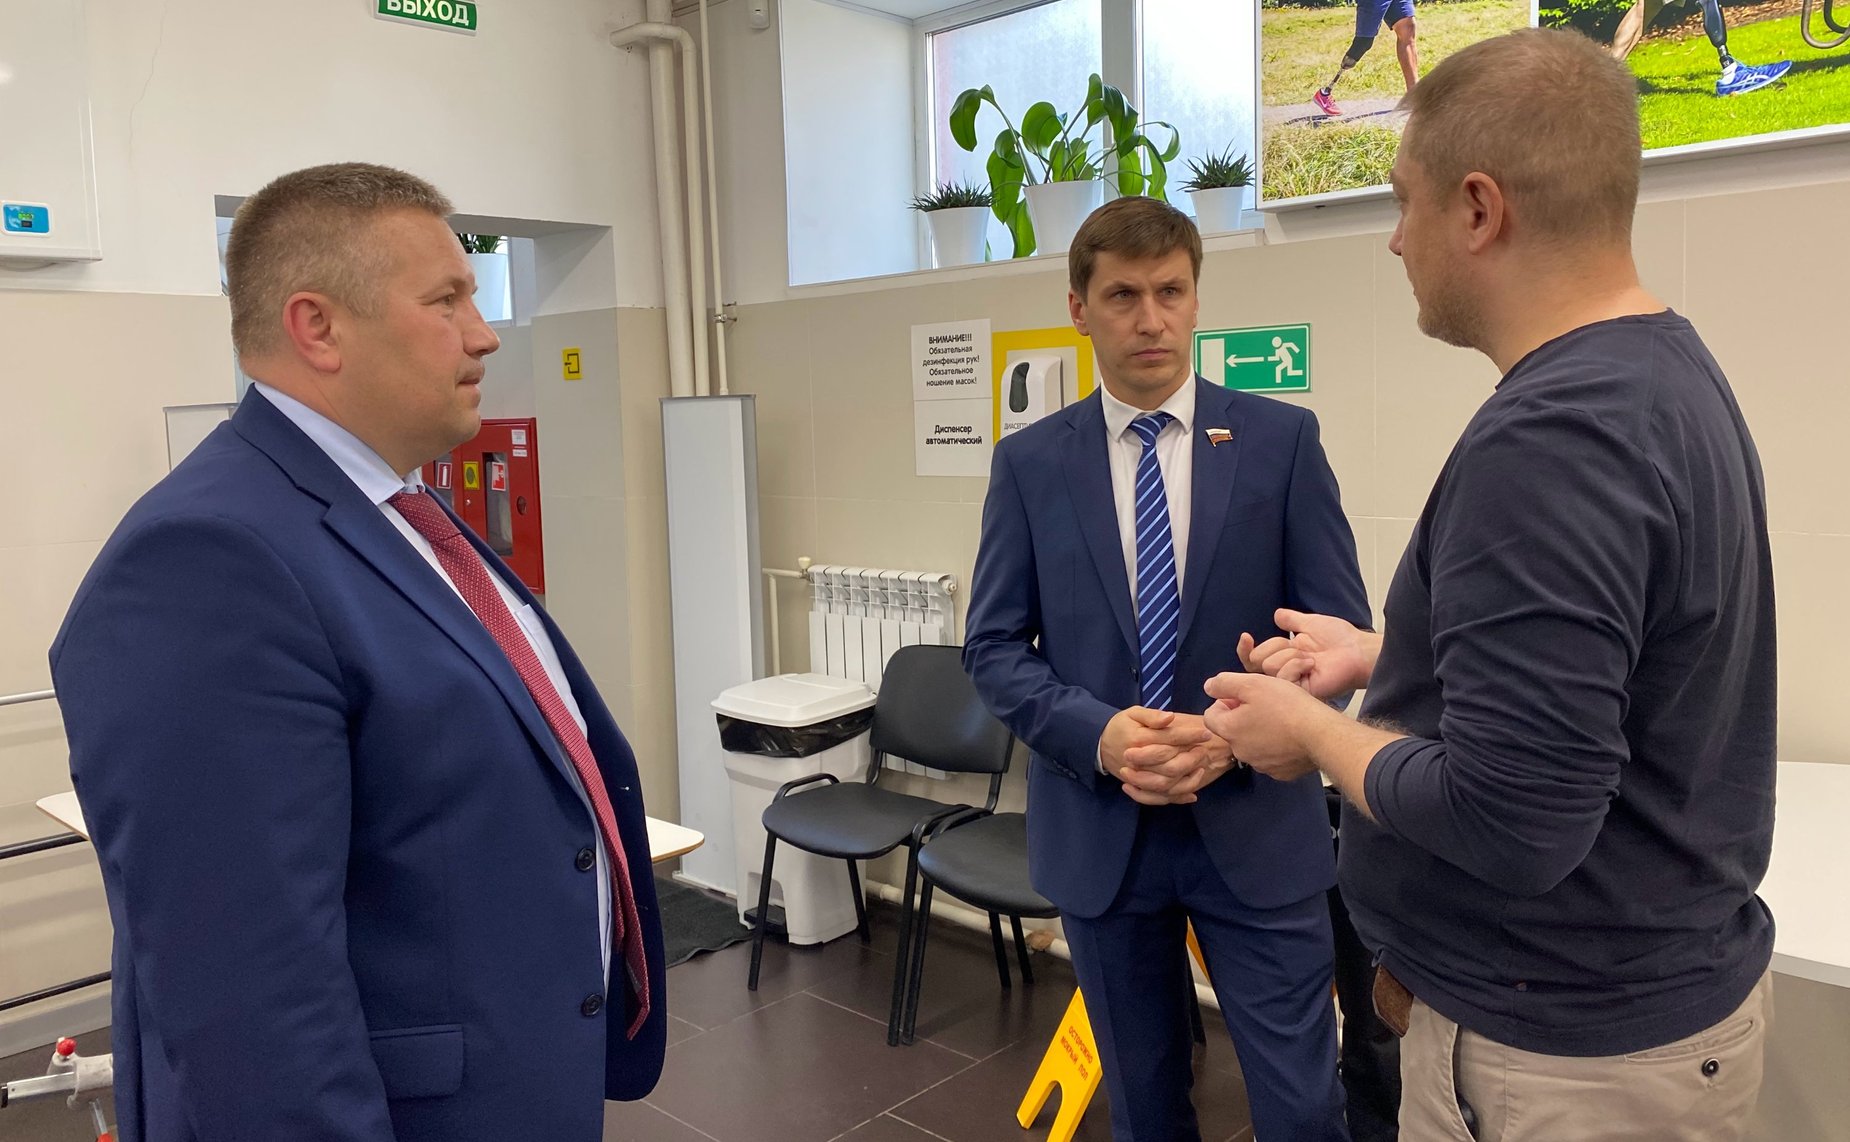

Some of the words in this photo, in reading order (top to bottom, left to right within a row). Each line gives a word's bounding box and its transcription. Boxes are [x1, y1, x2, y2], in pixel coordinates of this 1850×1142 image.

[387, 0, 469, 26] ВЫХОД
[928, 333, 972, 344] ВНИМАНИЕ!!!
[928, 346, 973, 355] Обязательная
[922, 357, 965, 367] дезинфекция
[966, 354, 980, 365] рук!
[929, 367, 974, 376] Обязательное
[926, 379, 954, 387] ношение
[955, 376, 977, 385] масок!
[934, 424, 973, 435] Диспенсер
[925, 435, 983, 445] автоматический
[1068, 1025, 1093, 1064] ОСТОРОЖНО
[1060, 1036, 1079, 1065] МОКРЫЙ
[1079, 1063, 1089, 1081] ПОЛ
